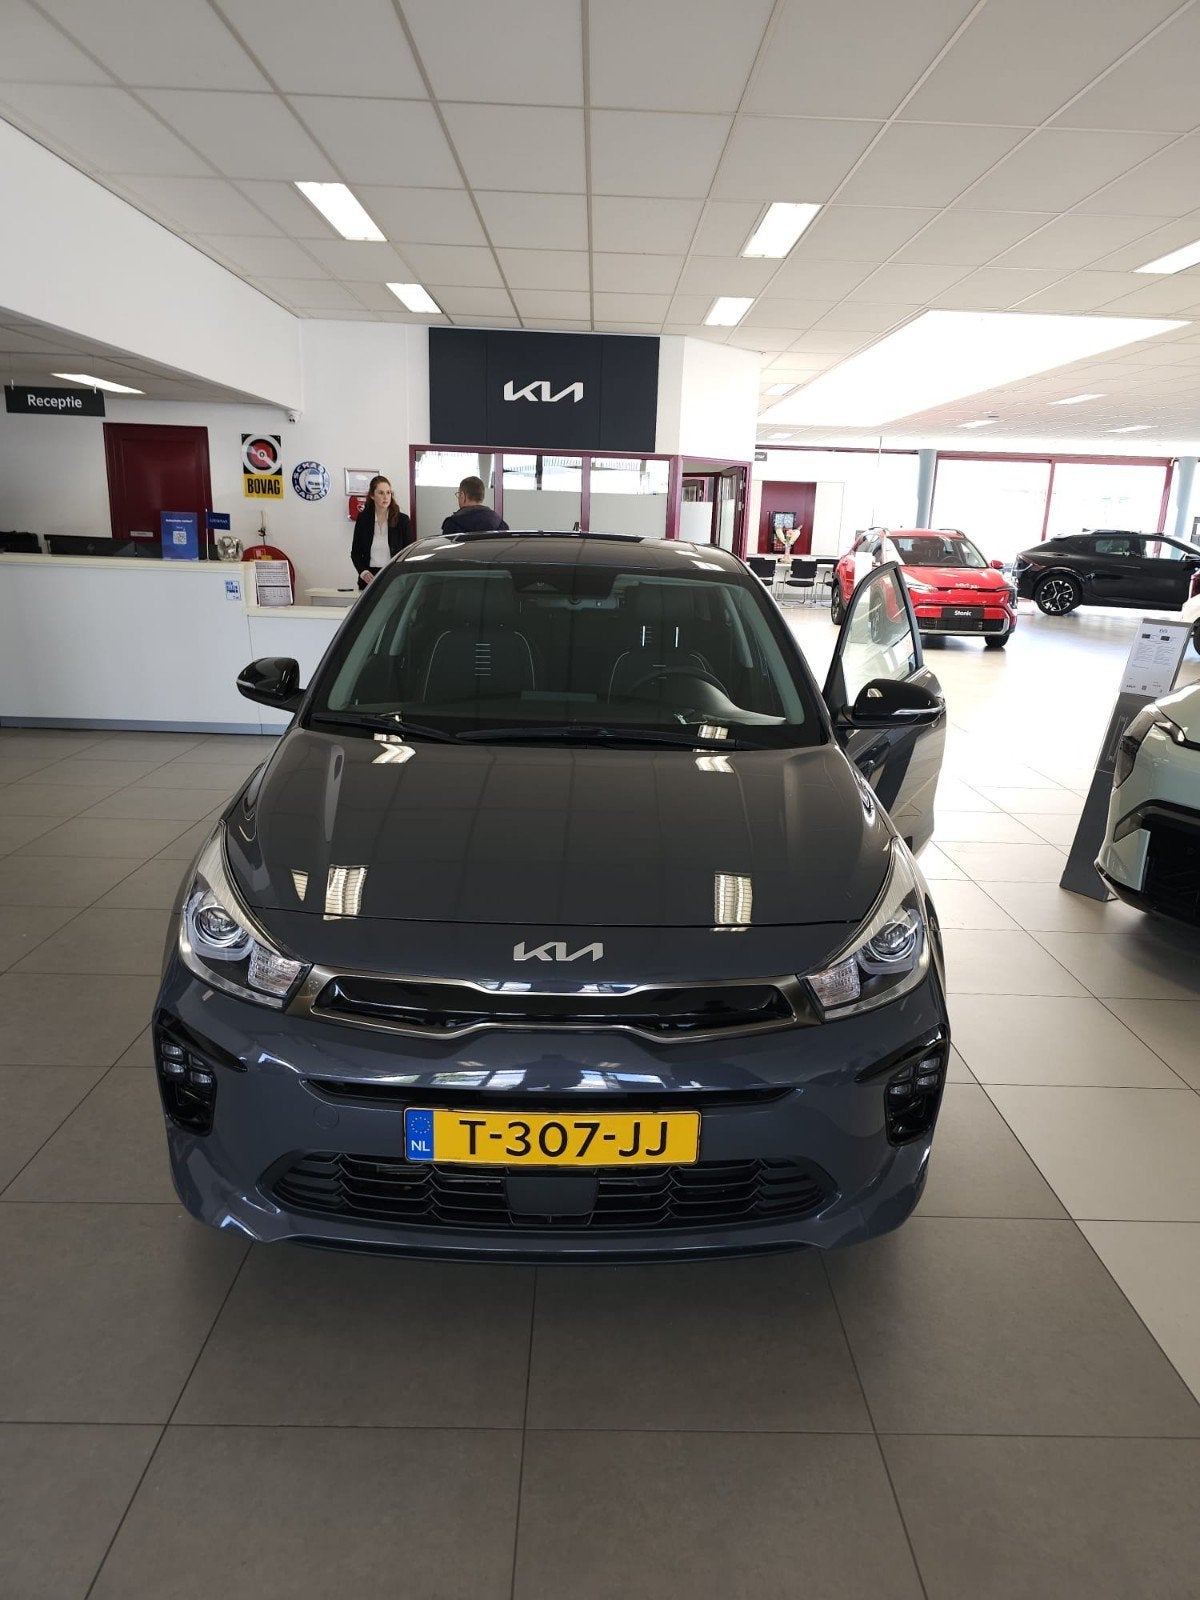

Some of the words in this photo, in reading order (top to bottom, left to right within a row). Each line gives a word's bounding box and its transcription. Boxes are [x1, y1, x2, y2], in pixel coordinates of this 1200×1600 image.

[503, 380, 584, 403] KIA
[27, 394, 83, 410] Receptie
[247, 478, 281, 495] BOVAG
[513, 941, 604, 962] KIA
[411, 1140, 430, 1152] NL
[459, 1119, 668, 1158] T-307-JJ
